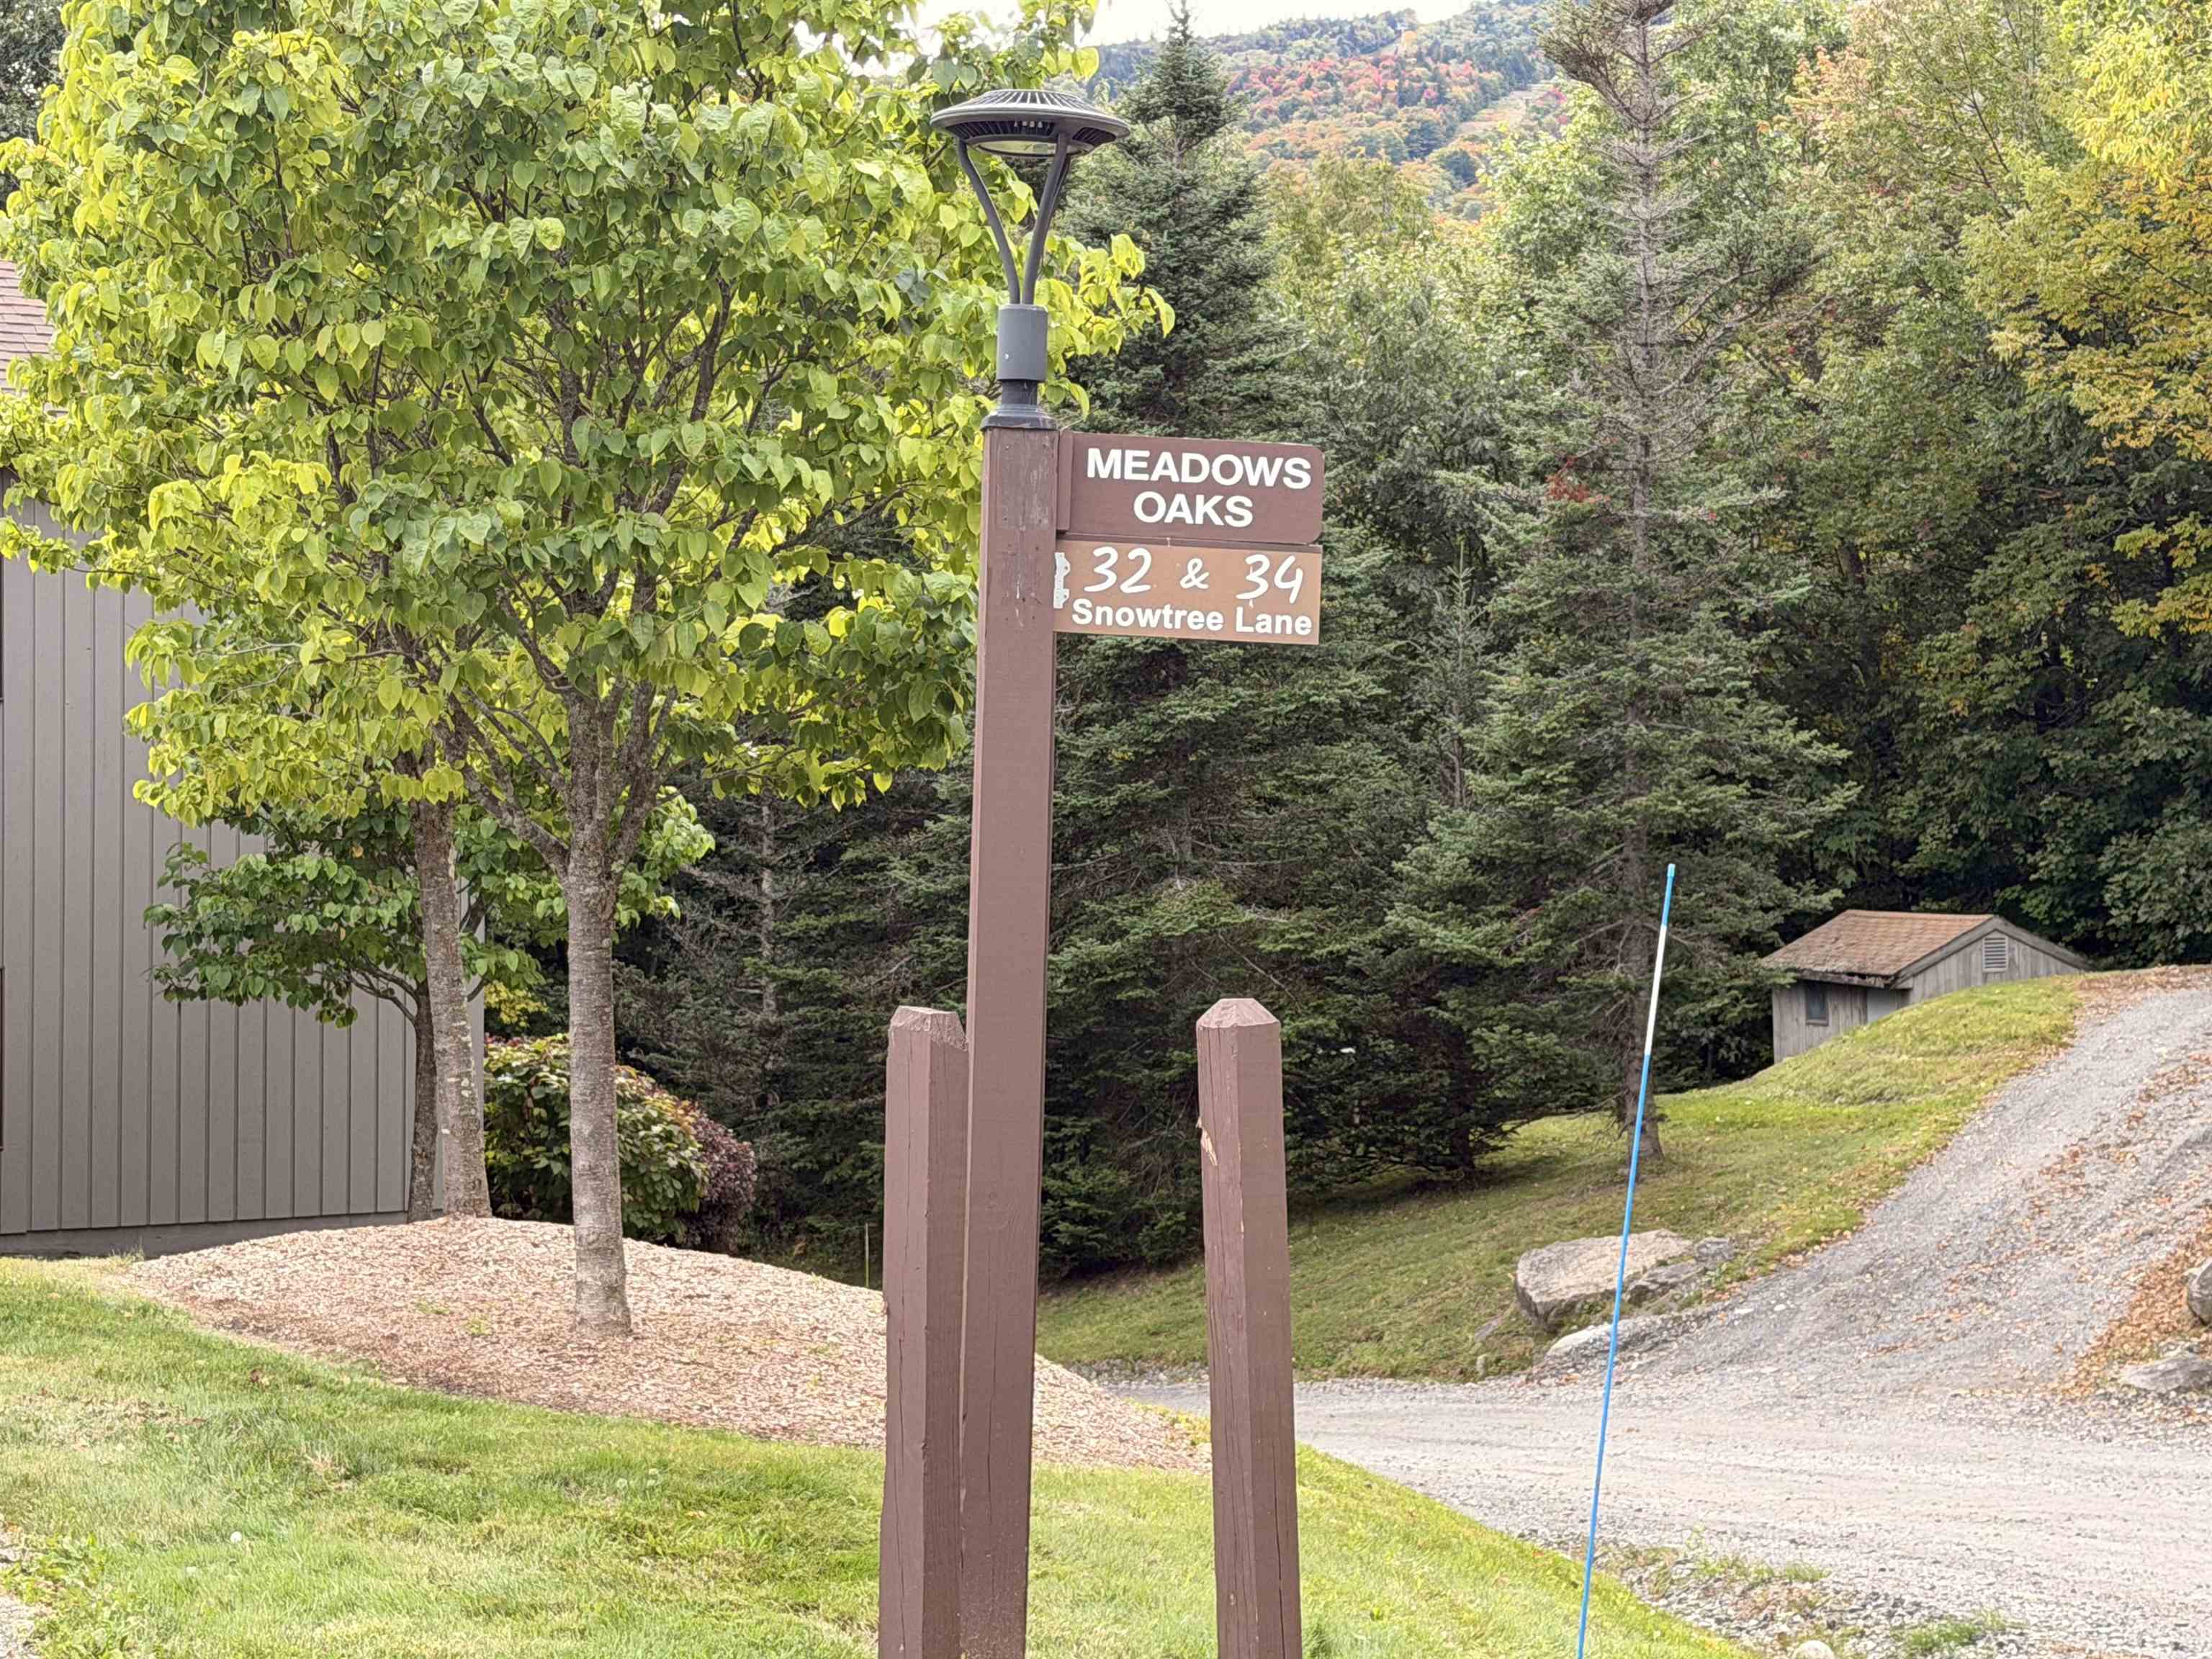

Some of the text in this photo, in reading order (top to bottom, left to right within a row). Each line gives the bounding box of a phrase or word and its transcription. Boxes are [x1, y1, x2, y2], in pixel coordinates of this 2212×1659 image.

[1087, 448, 1312, 490] MEADOWS
[1133, 491, 1253, 528] OAKS
[1084, 547, 1303, 603] 32 & 34
[1071, 598, 1313, 636] Snowtree Lane
